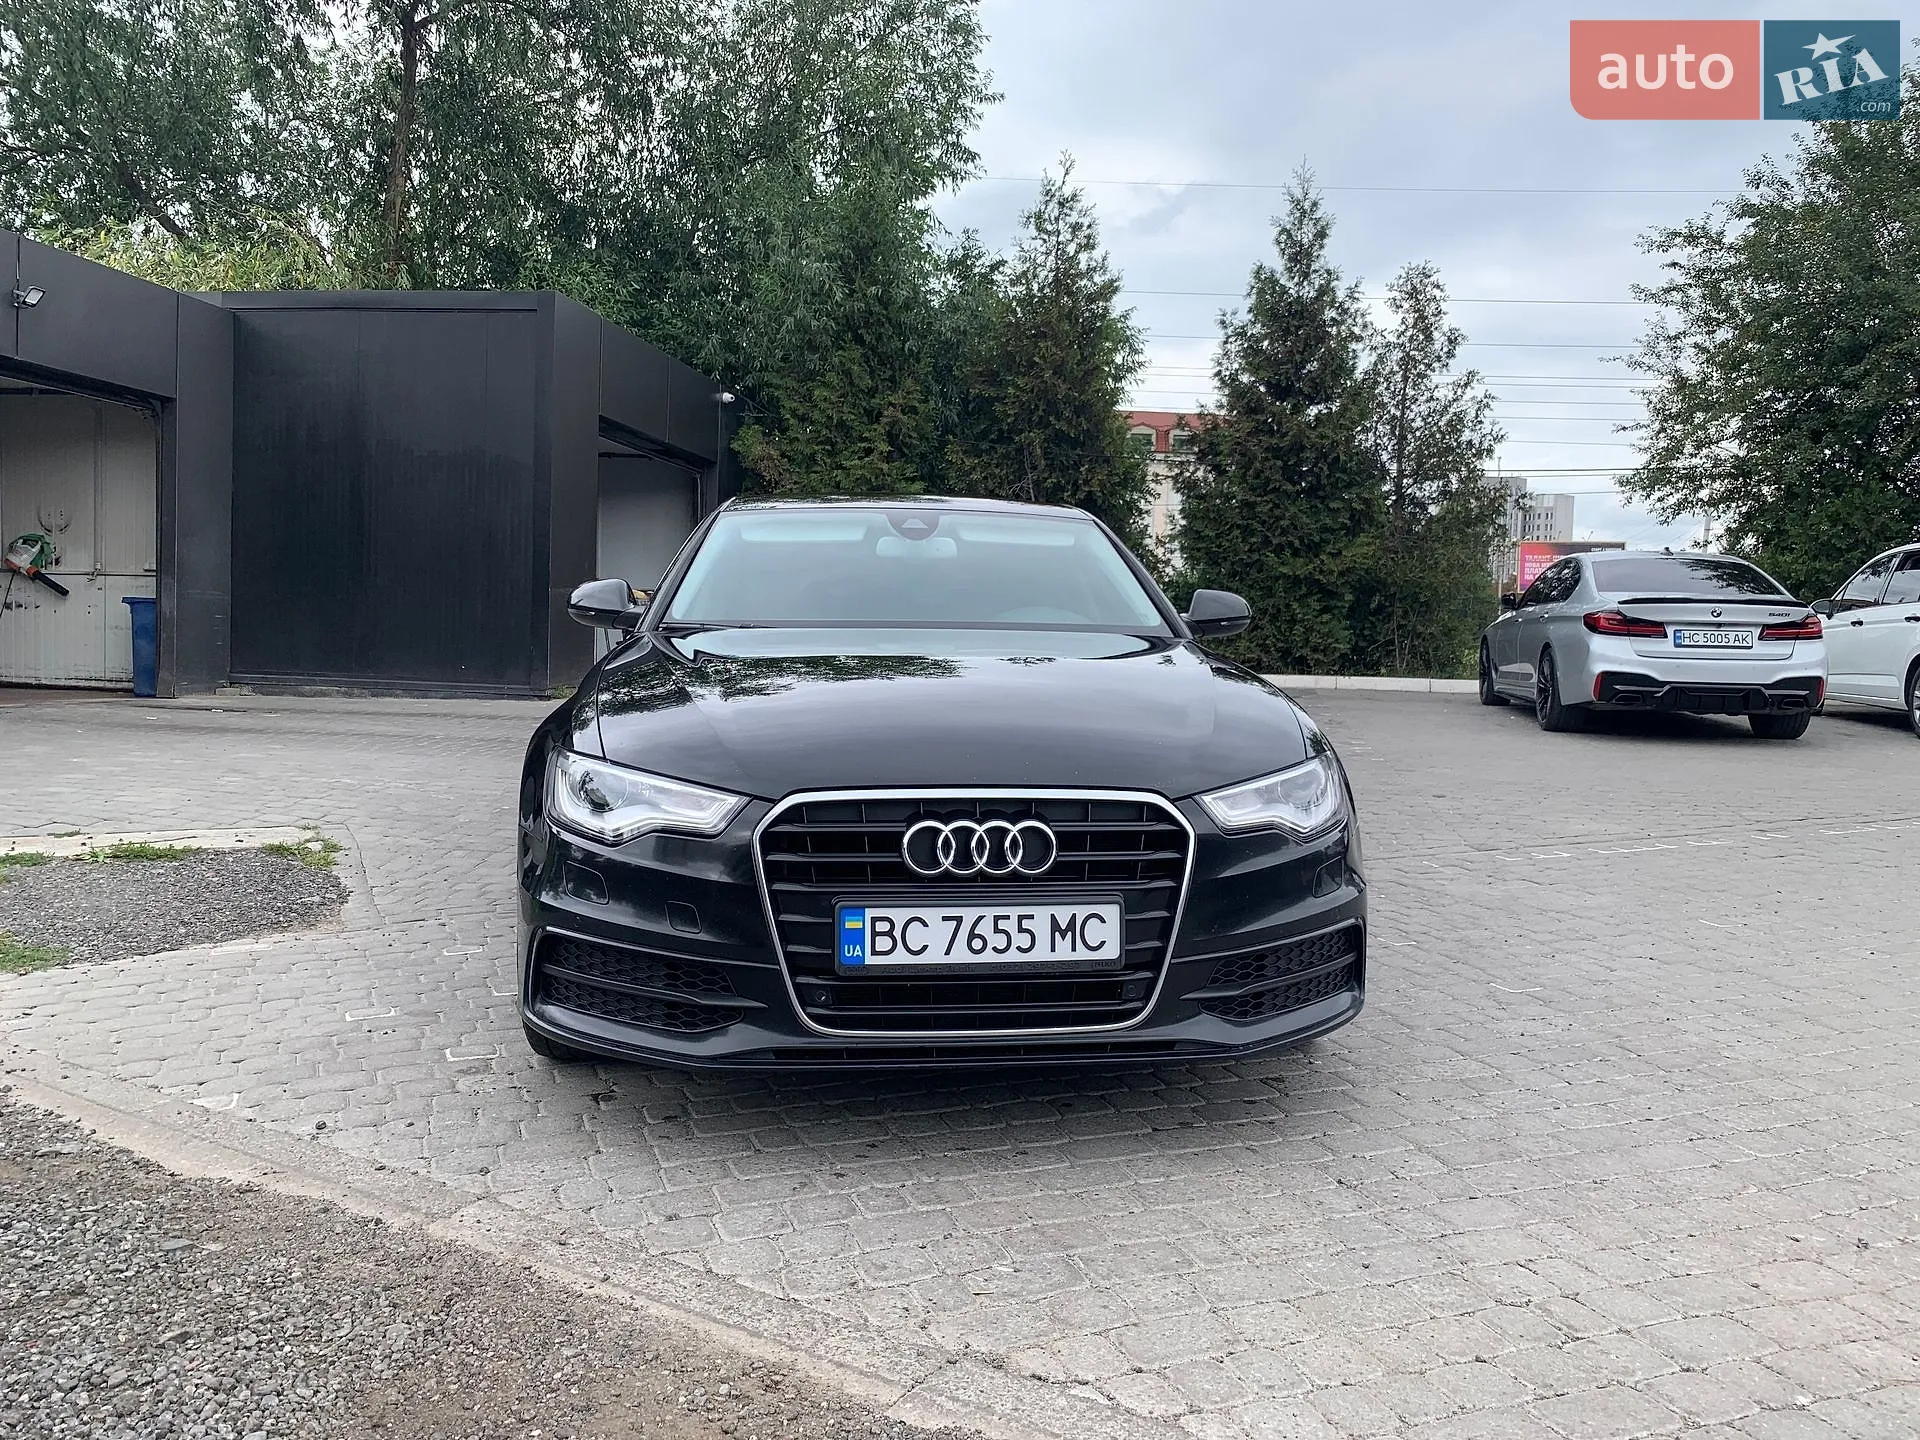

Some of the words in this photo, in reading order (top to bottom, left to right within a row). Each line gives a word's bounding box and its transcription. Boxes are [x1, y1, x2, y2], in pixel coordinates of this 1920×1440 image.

[1682, 632, 1700, 643] HC
[1702, 633, 1730, 643] 5005
[1733, 634, 1750, 645] AK
[870, 915, 930, 957] BC
[941, 914, 1036, 956] 7655
[1050, 912, 1107, 952] MC
[844, 945, 862, 957] UA
